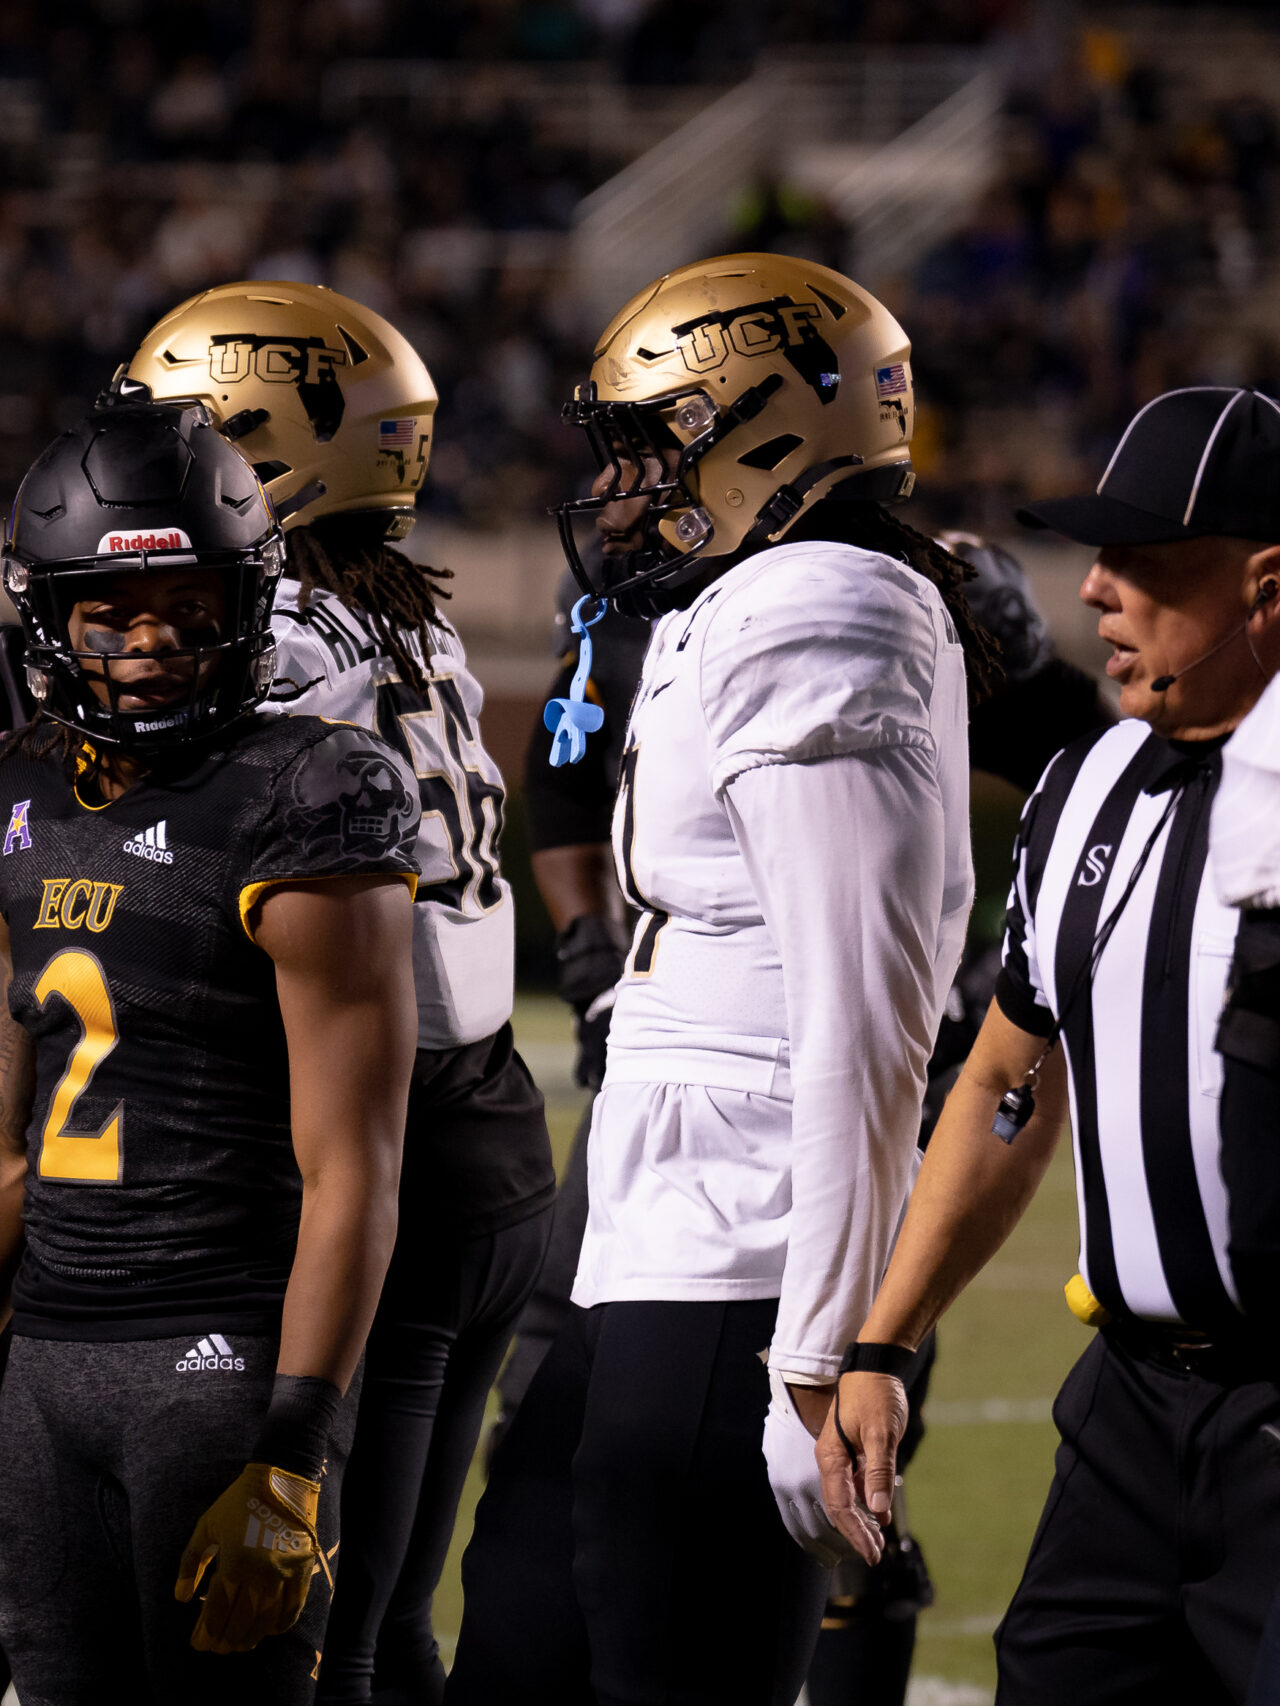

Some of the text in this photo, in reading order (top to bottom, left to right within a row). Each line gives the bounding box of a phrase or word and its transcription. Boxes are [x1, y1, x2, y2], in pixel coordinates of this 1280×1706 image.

[676, 303, 822, 374] UCF
[208, 341, 347, 385] UCF
[109, 533, 181, 552] Riddell
[134, 713, 183, 733] Riddell
[3, 800, 32, 856] A
[123, 840, 174, 865] adidas
[32, 878, 125, 933] ECU
[30, 946, 125, 1186] 2
[176, 1354, 245, 1372] adidas
[247, 1497, 302, 1550] adidas
